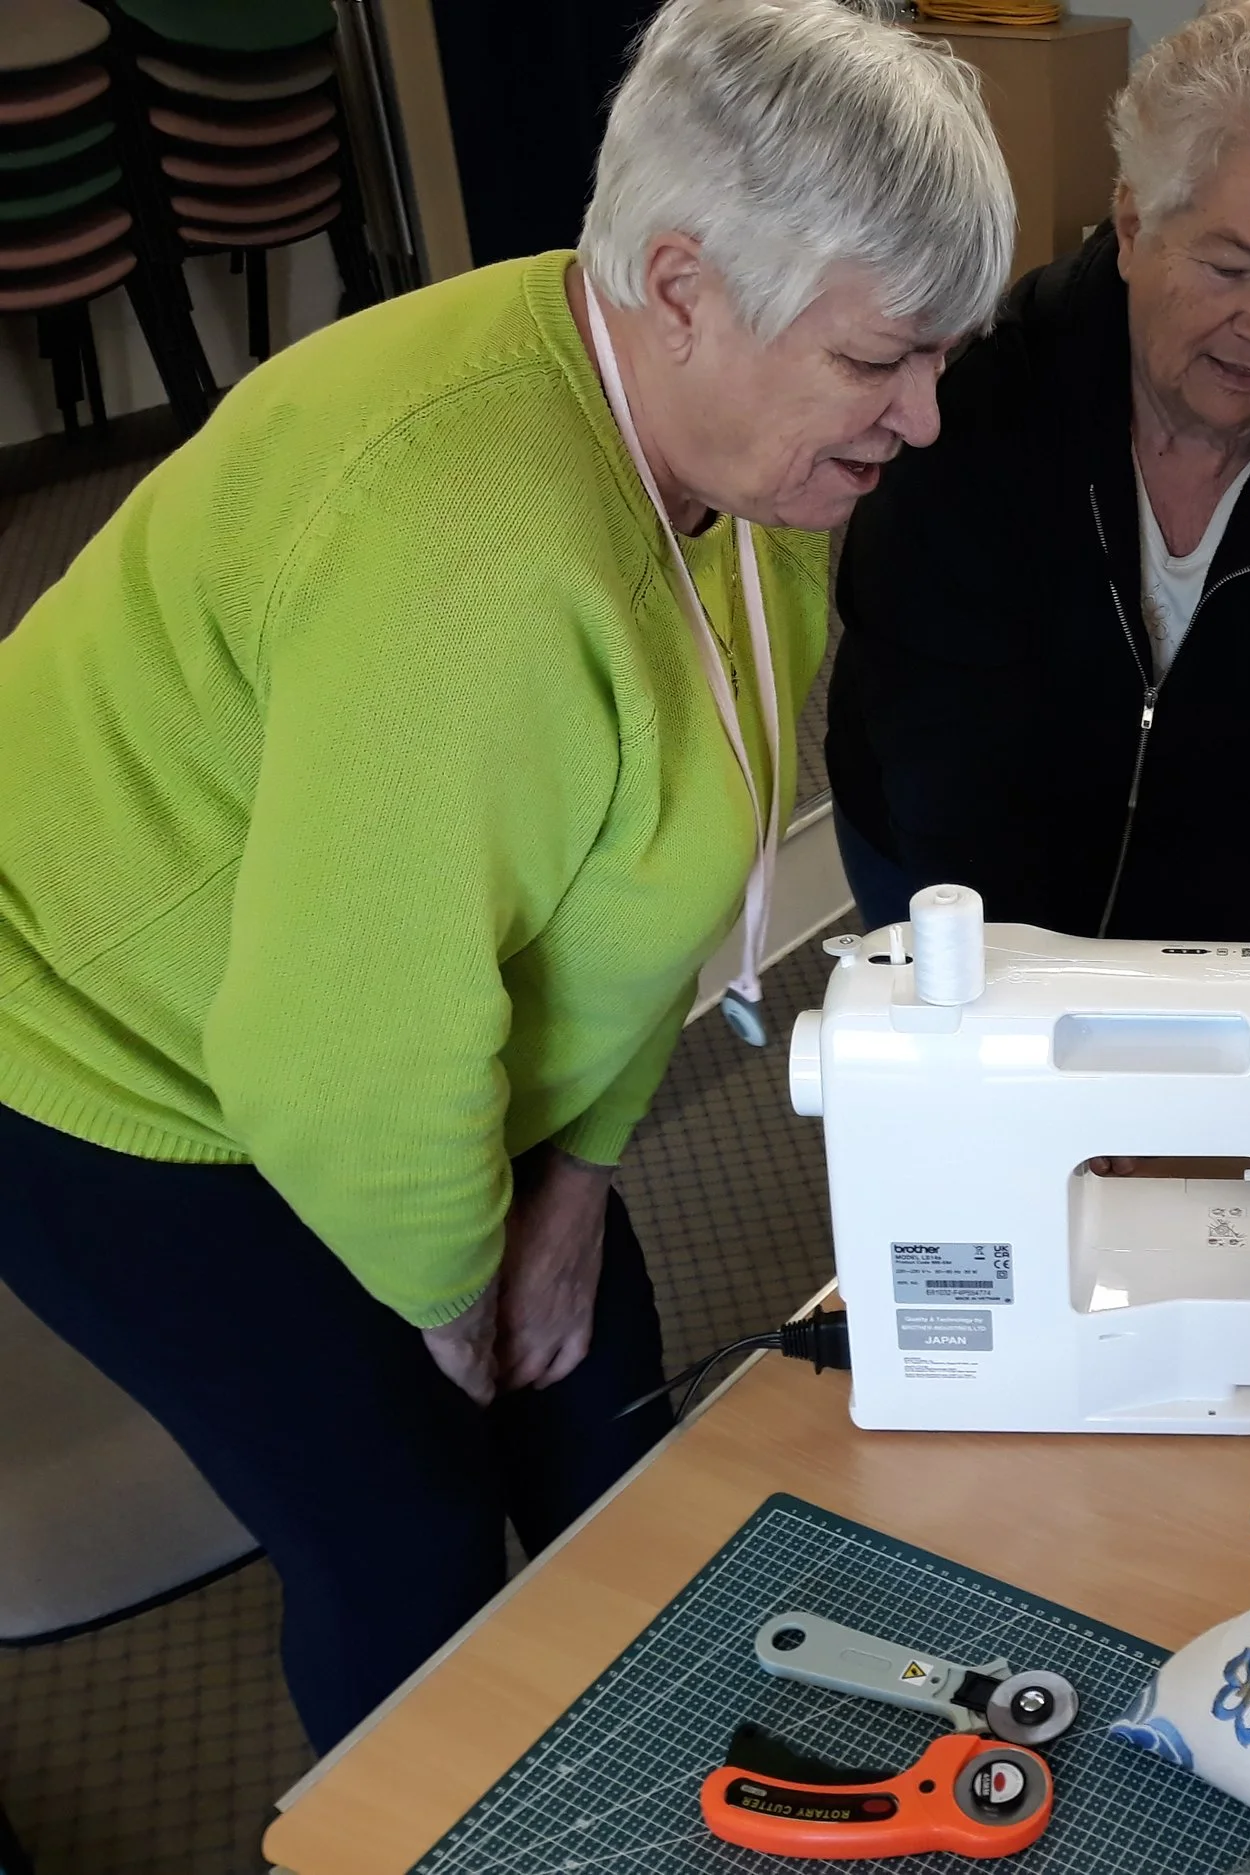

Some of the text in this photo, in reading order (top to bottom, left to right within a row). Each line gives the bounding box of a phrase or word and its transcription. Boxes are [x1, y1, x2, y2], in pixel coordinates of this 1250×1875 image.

[894, 1244, 940, 1254] brother
[924, 1335, 967, 1345] JAPAN
[742, 1795, 851, 1820] ROTARY CUTTER
